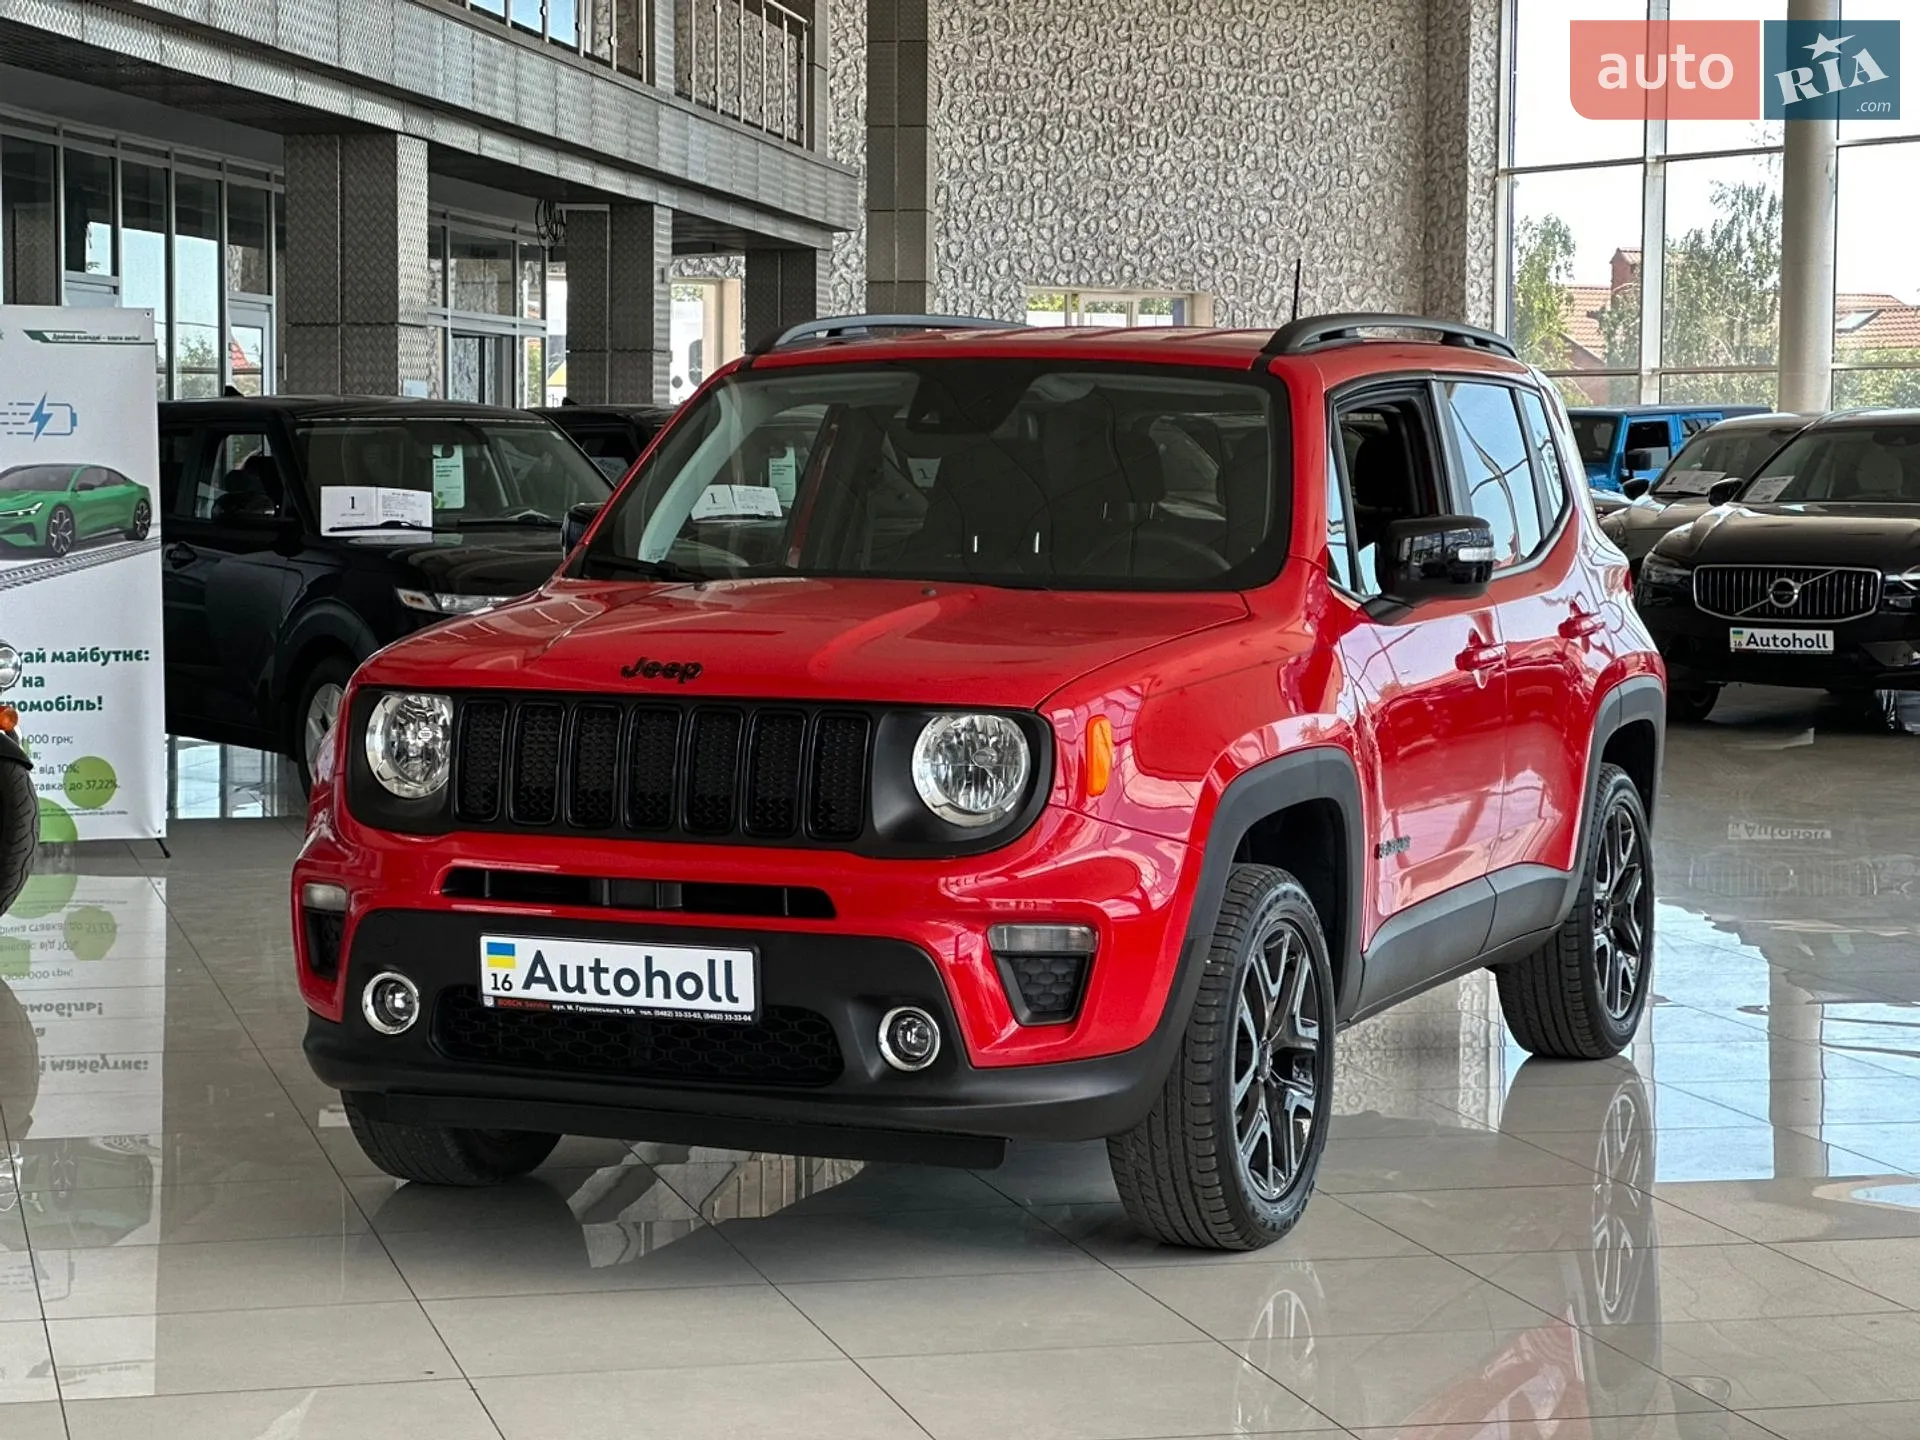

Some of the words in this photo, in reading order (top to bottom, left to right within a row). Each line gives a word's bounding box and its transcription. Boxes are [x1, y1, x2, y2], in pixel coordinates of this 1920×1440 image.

[1746, 632, 1828, 648] Autoholl
[18, 648, 46, 663] ай
[51, 647, 150, 666] майбутнє:
[621, 656, 703, 684] Jeep
[22, 676, 45, 688] на
[52, 735, 73, 746] грн;
[39, 764, 55, 775] від
[491, 973, 513, 992] 16
[522, 949, 739, 1003] Autoholl
